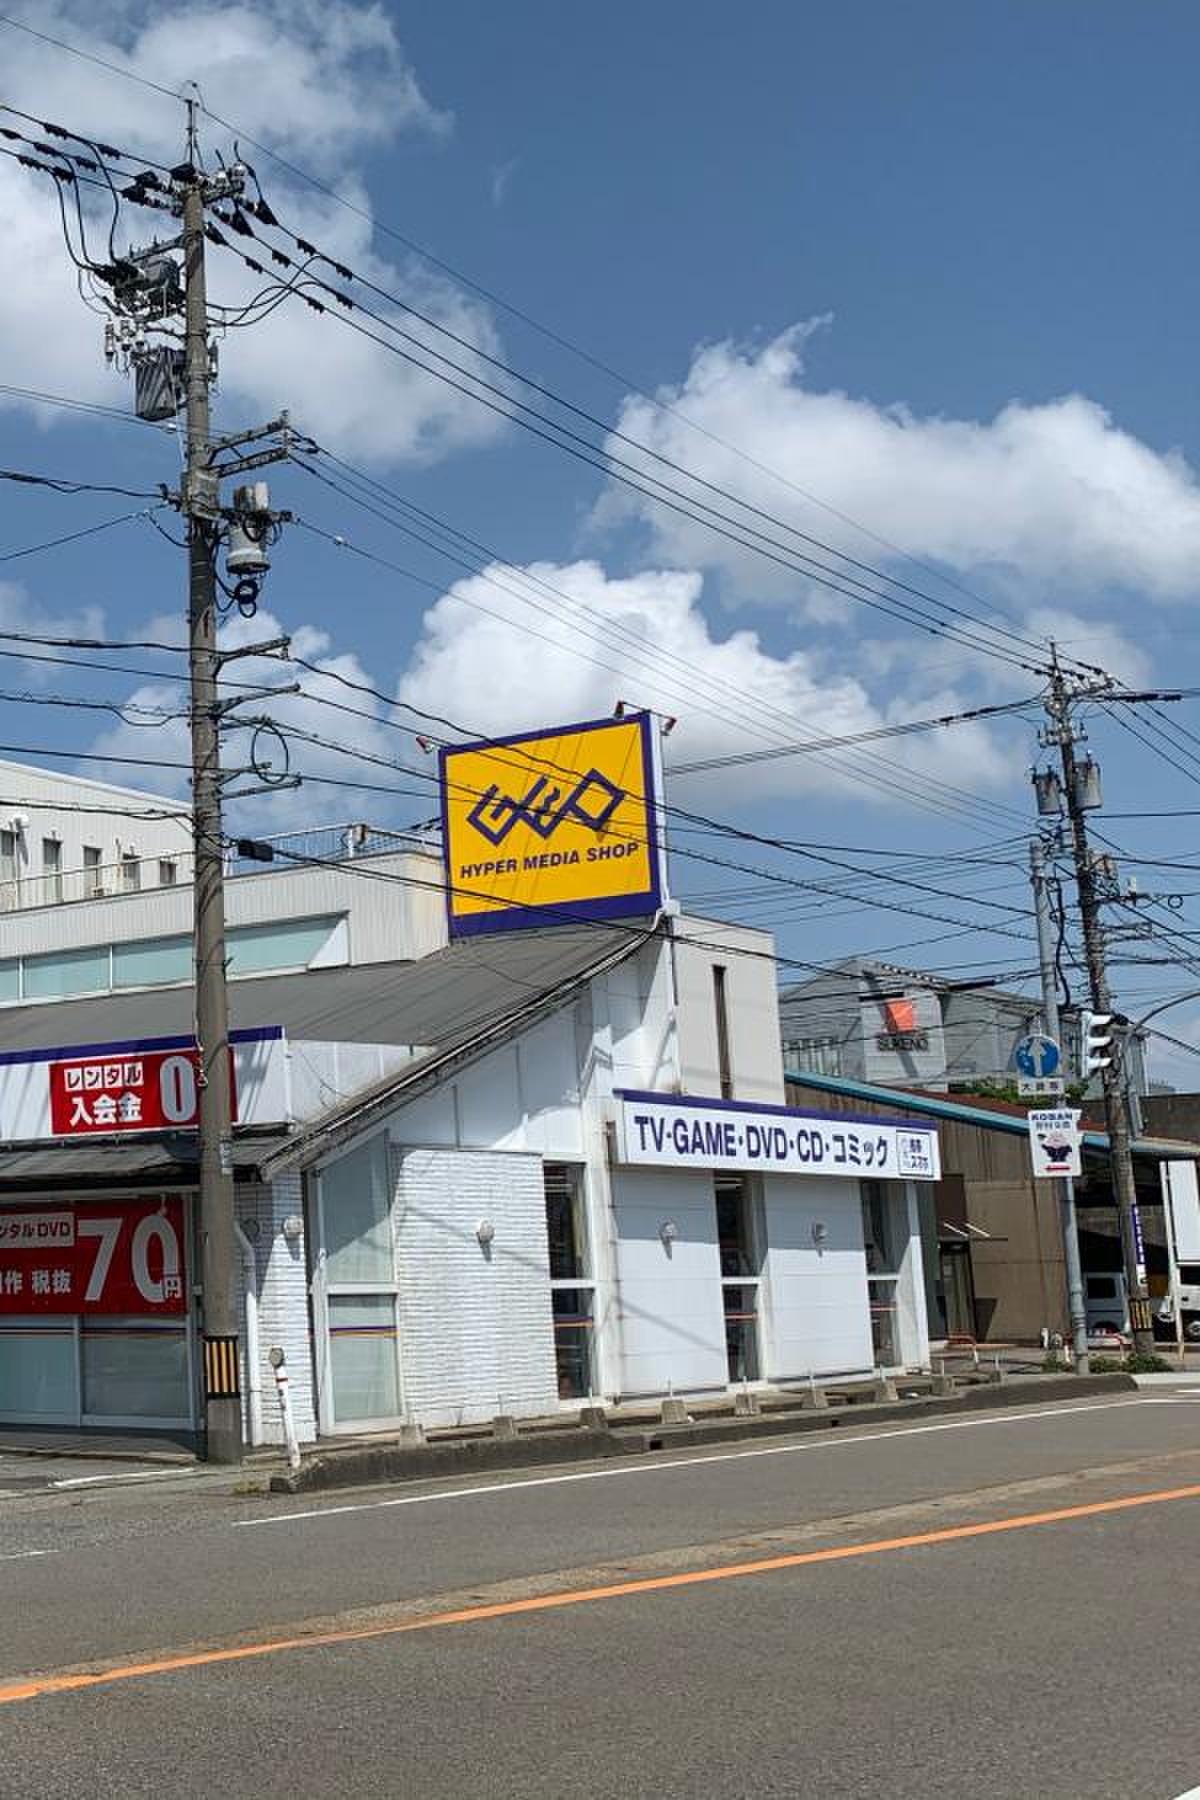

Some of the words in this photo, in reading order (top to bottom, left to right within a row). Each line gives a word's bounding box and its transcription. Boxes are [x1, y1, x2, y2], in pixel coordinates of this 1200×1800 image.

[467, 768, 626, 846] GEO
[459, 859, 517, 879] HYPER
[522, 849, 580, 871] MEDIA
[586, 842, 640, 863] SHOP
[65, 1064, 143, 1090] レンタル
[69, 1092, 143, 1127] 入会金
[31, 1269, 71, 1295] 税抜
